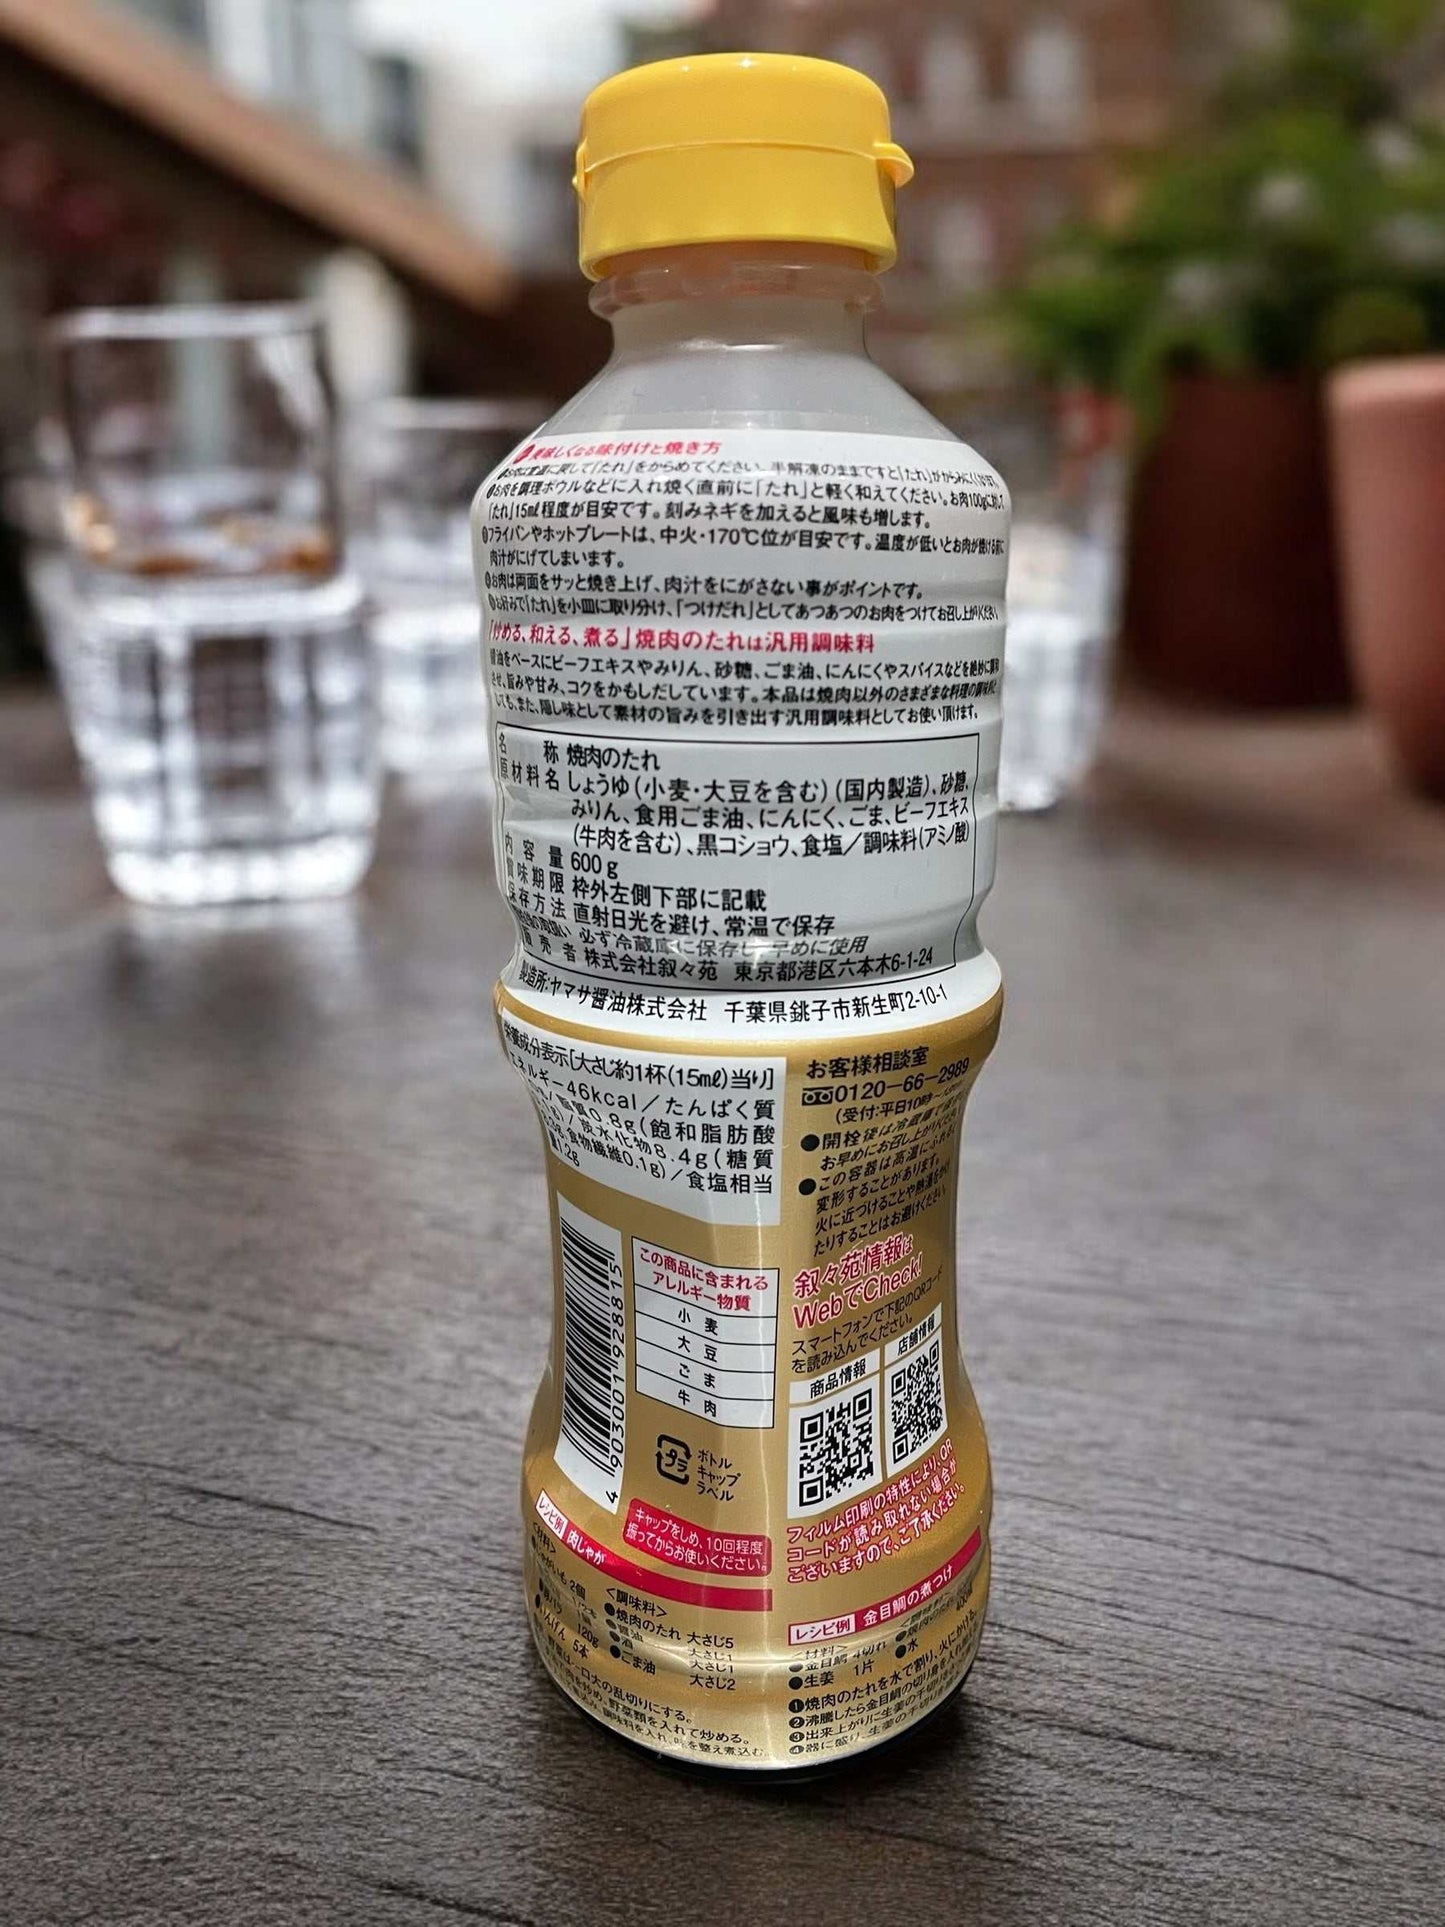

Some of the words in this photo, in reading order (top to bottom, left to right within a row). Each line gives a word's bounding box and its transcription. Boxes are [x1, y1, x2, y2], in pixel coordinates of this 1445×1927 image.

[490, 549, 625, 568] 肉汁がにげてしまいます。
[490, 619, 875, 654] 「炒める、和える、煮る」焼肉のたれは汎用調味料
[566, 743, 661, 772] 焼肉のたれ
[572, 875, 767, 912] 枠外左側下部に記載
[573, 902, 835, 938] 直射日光を避け、常温で保存
[584, 947, 719, 982] 株式会社叙々苑
[733, 946, 933, 982] 東京都港区六本木6-1-24
[724, 983, 948, 1023] 千葉県銚子市新生町2-10-1
[806, 1045, 929, 1079] お客様相談室
[640, 1246, 769, 1291] この商品に含まれる
[792, 1231, 915, 1300] 叙々苑情報は
[652, 1270, 752, 1312] アレルギー物質
[791, 1312, 913, 1374] を読み込んでください。
[897, 1311, 936, 1356] 店舗情報
[809, 1357, 867, 1400] 商品情報
[696, 1466, 742, 1488] キャップ
[697, 1449, 733, 1469] ボトル
[696, 1480, 735, 1502] ラベル
[566, 1530, 608, 1567] 肉じゃが
[625, 1521, 768, 1572] 振ってからお使いください。
[634, 1506, 765, 1556] キャップをしめ、10回程度
[795, 1617, 851, 1640] レシピ例
[862, 1563, 954, 1627] 金目鯛の煮つけ
[615, 1607, 681, 1641] 焼肉のたれ
[686, 1631, 734, 1650] 大さじ5
[621, 1650, 656, 1676] ごま油
[689, 1674, 737, 1691] 大さじ2
[803, 1670, 835, 1690] 生姜
[852, 1658, 876, 1677] 1片
[907, 1637, 919, 1653] 水
